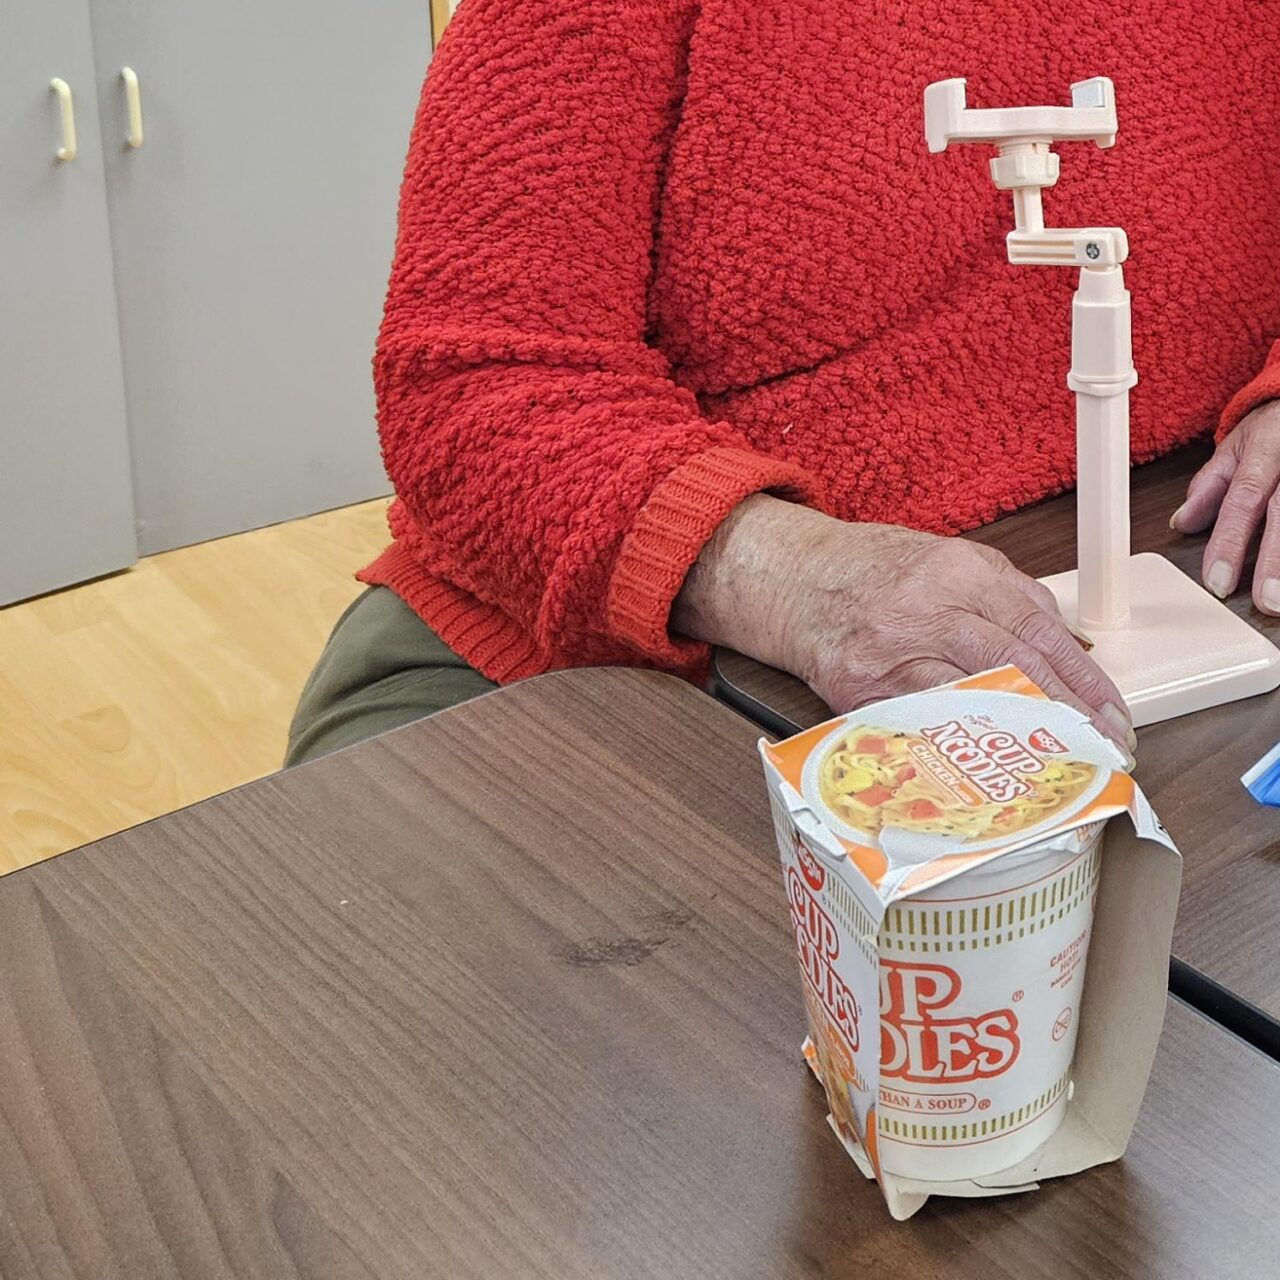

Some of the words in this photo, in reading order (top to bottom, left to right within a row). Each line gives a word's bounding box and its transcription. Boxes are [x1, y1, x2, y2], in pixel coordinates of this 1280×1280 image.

[912, 745, 960, 788] CHICKEN
[920, 721, 1032, 803] NOODLES
[977, 730, 1046, 774] CUP
[788, 866, 839, 960] CUP
[880, 1092, 910, 1107] HAN
[915, 1098, 924, 1109] A
[928, 1097, 968, 1110] SOUP
